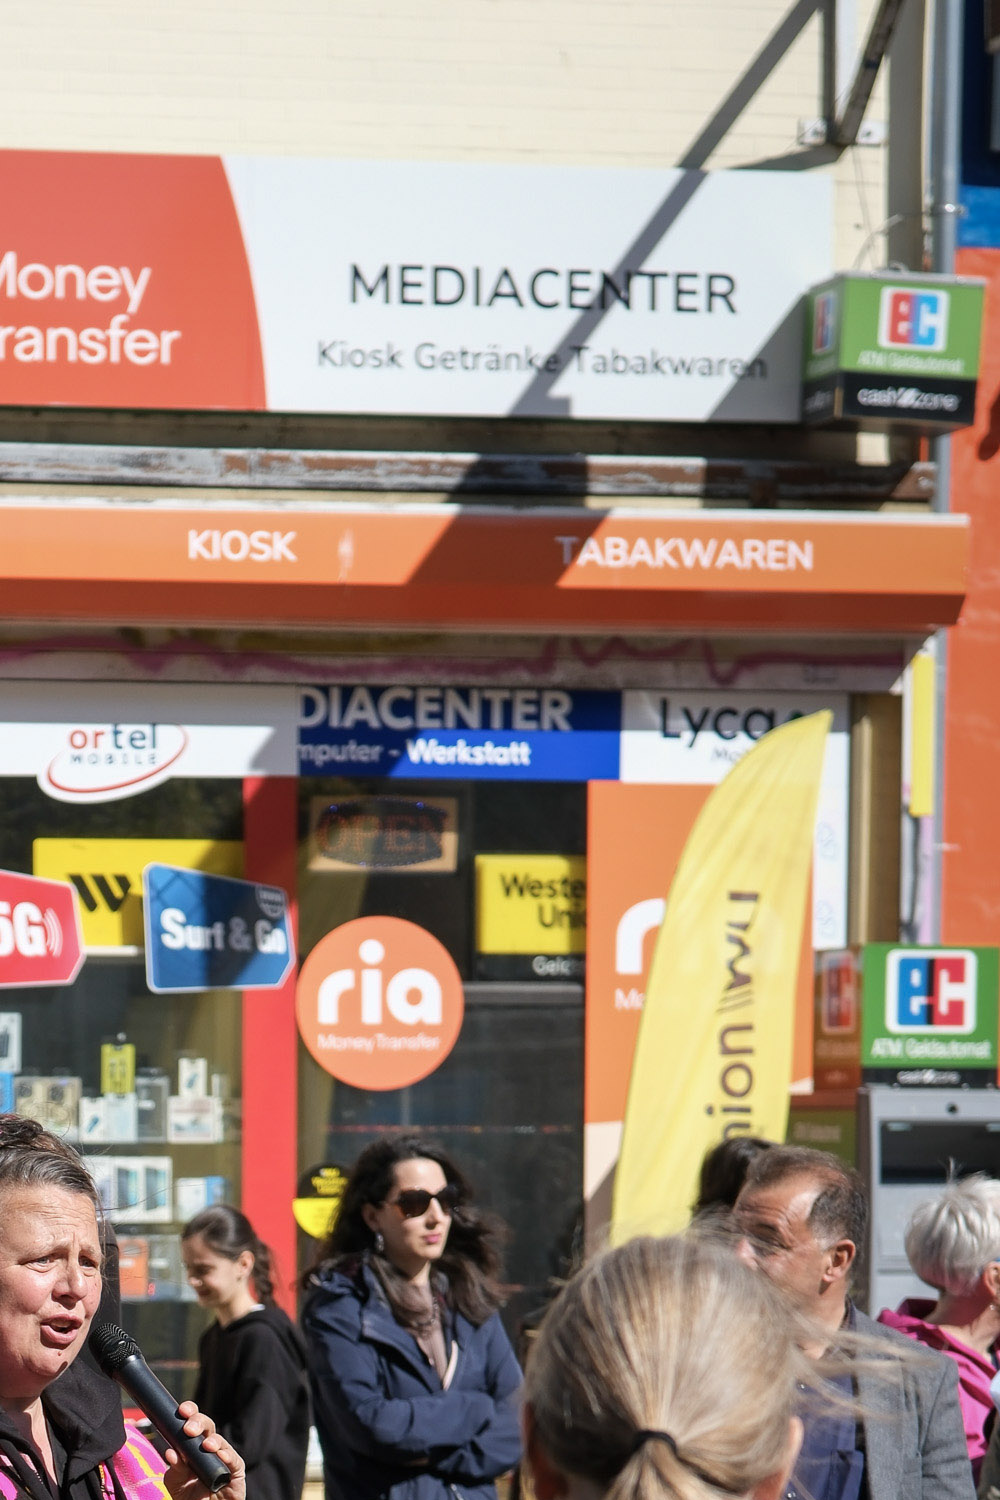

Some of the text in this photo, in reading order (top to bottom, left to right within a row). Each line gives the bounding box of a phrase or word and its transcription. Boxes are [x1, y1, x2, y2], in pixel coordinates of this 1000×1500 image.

[350, 263, 738, 314] MEDIACENTER
[317, 340, 402, 370] Kiosk
[413, 341, 562, 375] Getränke
[570, 346, 768, 380] Tabakwaren
[187, 528, 297, 562] KIOSK
[555, 535, 814, 571] TABAKWAREN
[69, 722, 157, 750] ortel
[406, 738, 532, 766] Werkstatt
[316, 813, 444, 854] OPEN
[228, 916, 252, 952] &
[317, 939, 443, 1025] ria
[317, 1032, 442, 1055] Money Transfer
[871, 1038, 903, 1057] ATM
